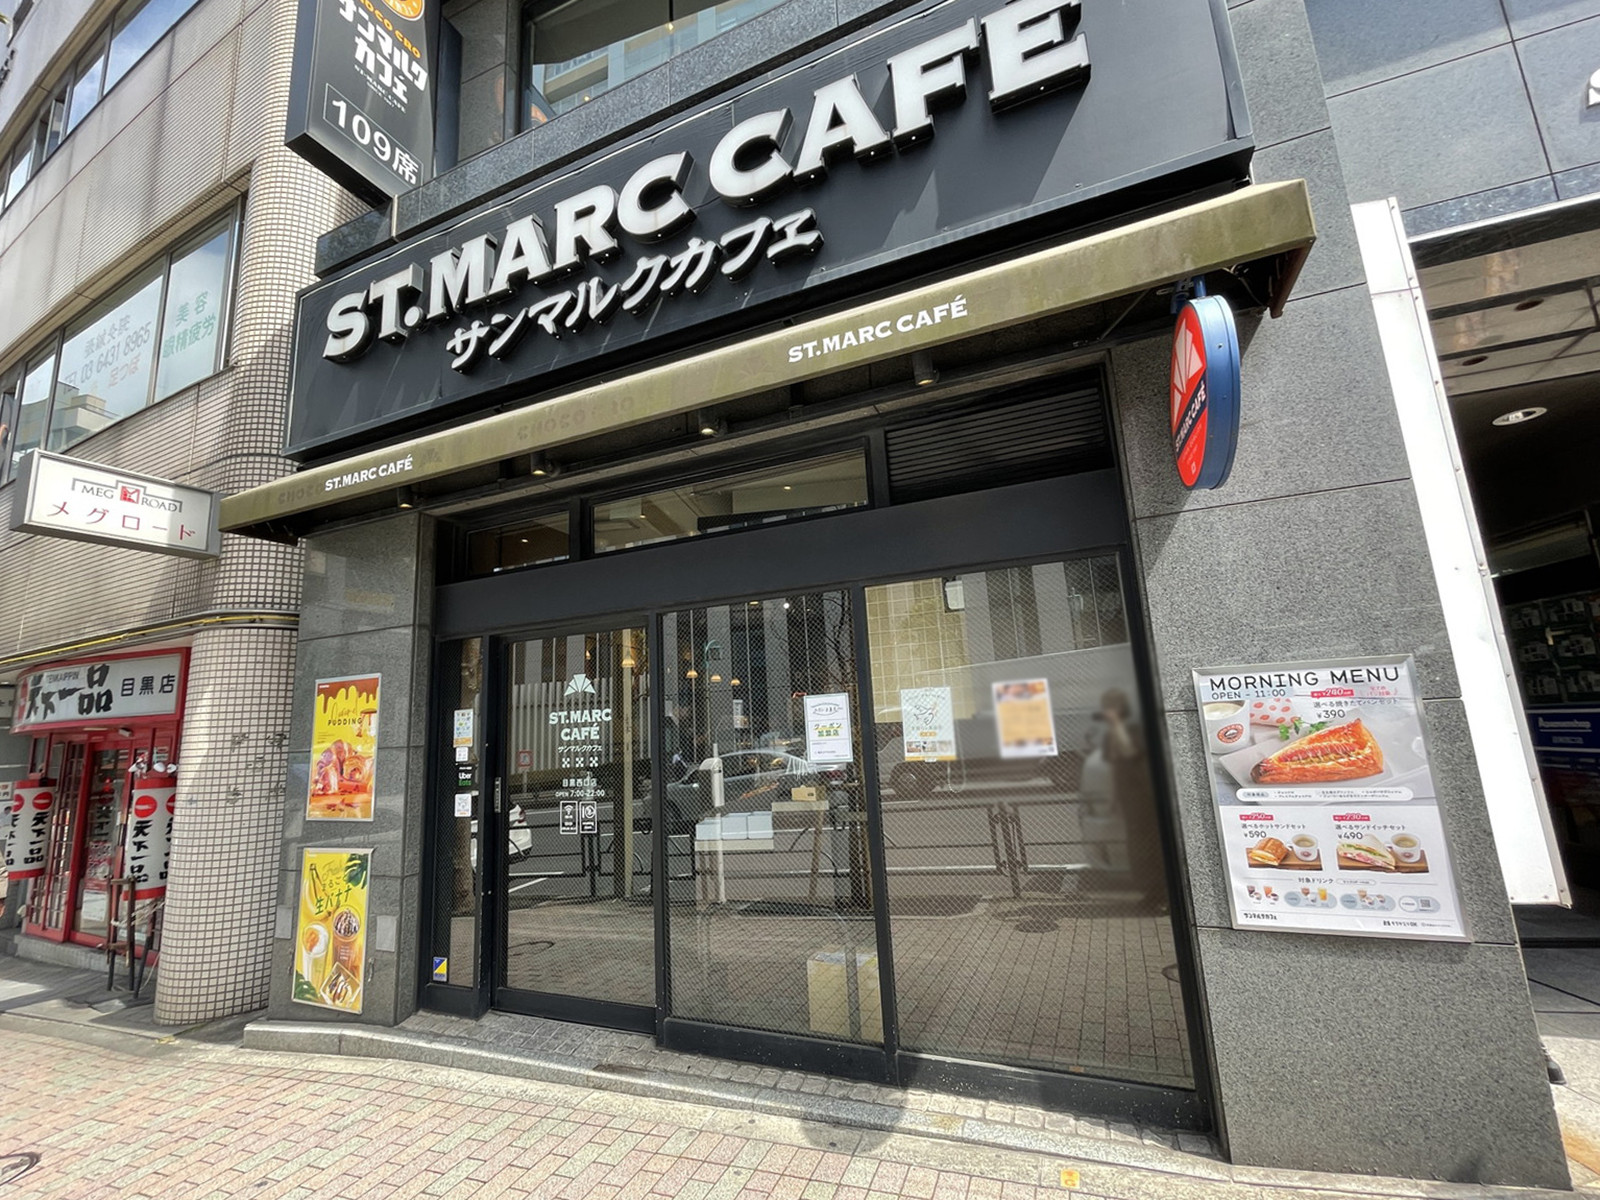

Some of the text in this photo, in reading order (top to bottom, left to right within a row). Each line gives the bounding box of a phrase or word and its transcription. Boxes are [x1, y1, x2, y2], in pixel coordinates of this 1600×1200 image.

[394, 30, 421, 58] CRO
[354, 36, 408, 104] カフェ
[332, 100, 419, 185] 109席
[322, 150, 696, 361] ST.MARC
[446, 208, 824, 372] サンマルクカフェ
[788, 294, 968, 363] ST.MARC CAFÉ
[80, 359, 94, 384] 03
[96, 342, 121, 374] 6431
[124, 321, 152, 357] 8965
[325, 467, 377, 491] ST.MARC
[378, 454, 413, 477] CAFÉ
[81, 485, 178, 512] MEG ROAD
[47, 501, 196, 540] メグロード
[120, 674, 176, 697] 目黒店
[1209, 666, 1400, 691] MORNING MENU
[1211, 691, 1242, 700] OPEN
[1255, 689, 1286, 698] 11:00
[328, 717, 363, 726] PUDDING
[549, 708, 612, 725] ST.MARC
[1316, 709, 1346, 719] ¥390
[560, 723, 600, 741] CAFÉ
[557, 744, 603, 754] サンマルクカフェ
[458, 772, 472, 780] Uber
[1244, 830, 1267, 838] ¥590
[1338, 831, 1363, 840] ¥490
